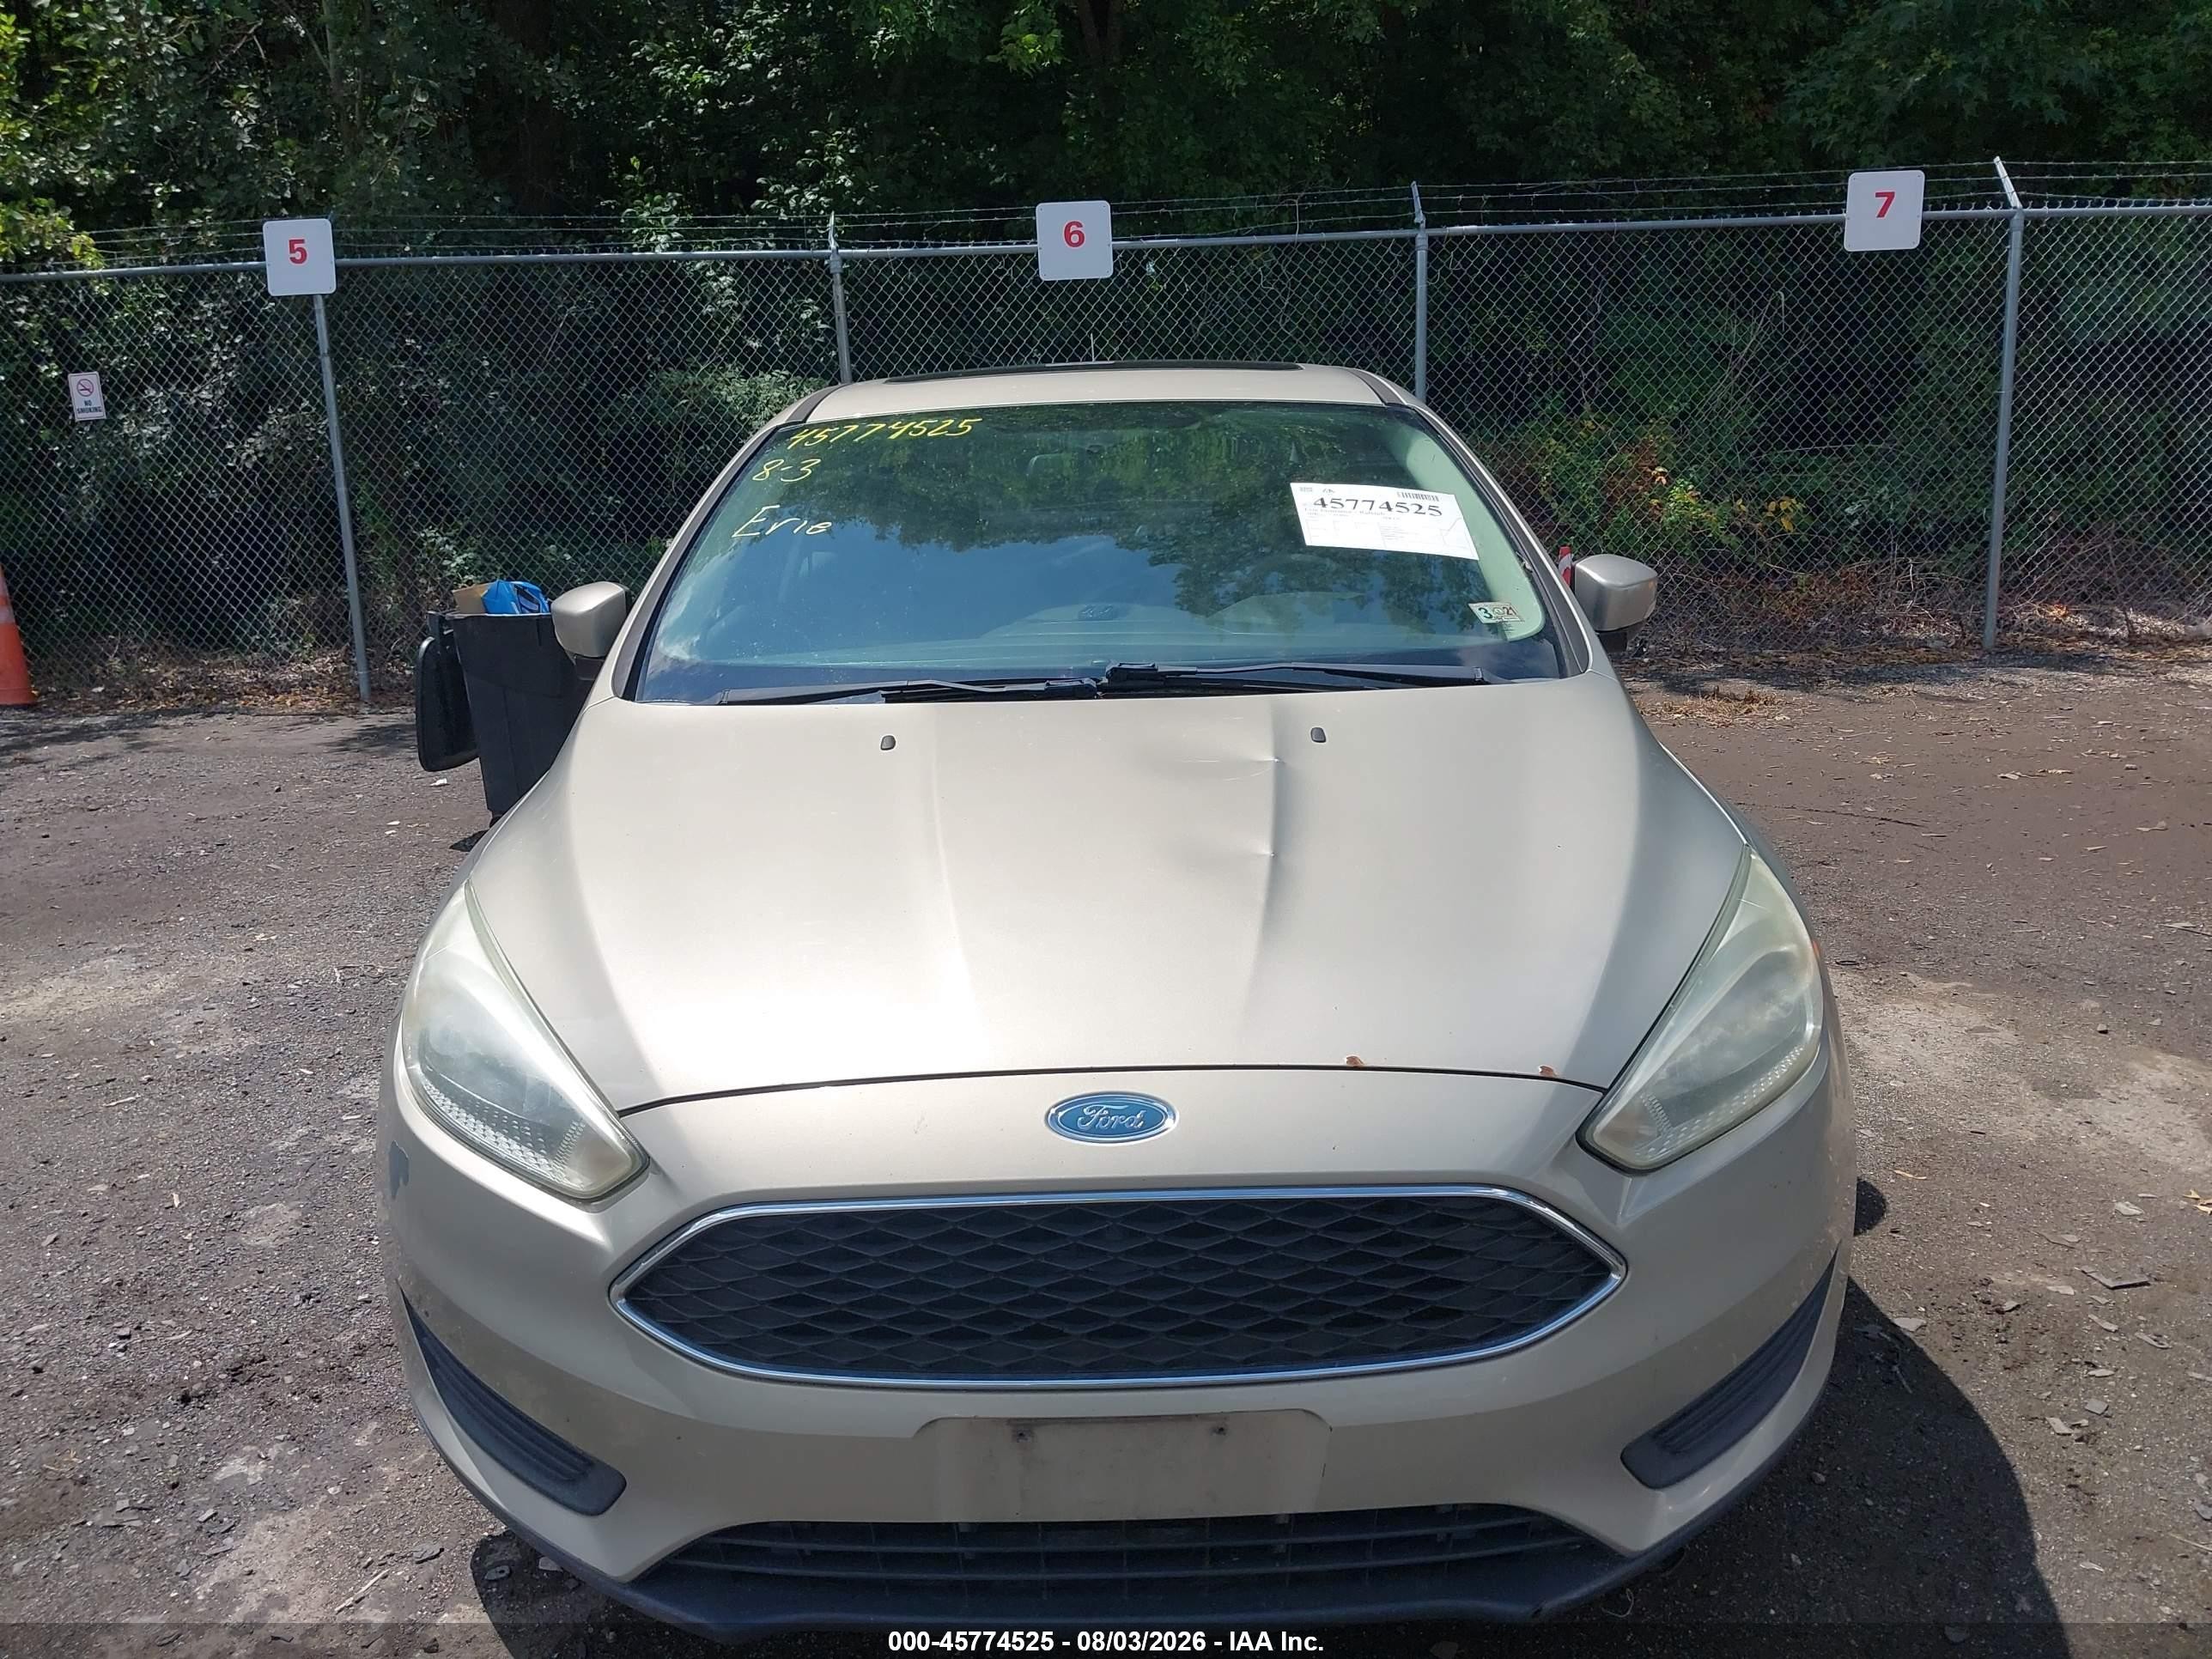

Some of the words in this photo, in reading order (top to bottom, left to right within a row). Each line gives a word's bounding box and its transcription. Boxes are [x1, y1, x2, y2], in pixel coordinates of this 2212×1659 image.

[1875, 191, 1896, 219] 7
[1063, 221, 1086, 248] 6
[289, 239, 307, 264] 5
[787, 418, 983, 450] 45774525
[752, 459, 822, 483] 8-3
[1313, 496, 1443, 517] 45774525
[732, 504, 832, 538] Erie
[1478, 607, 1493, 619] 3
[1502, 606, 1517, 616] 21
[1077, 1104, 1146, 1130] Ford
